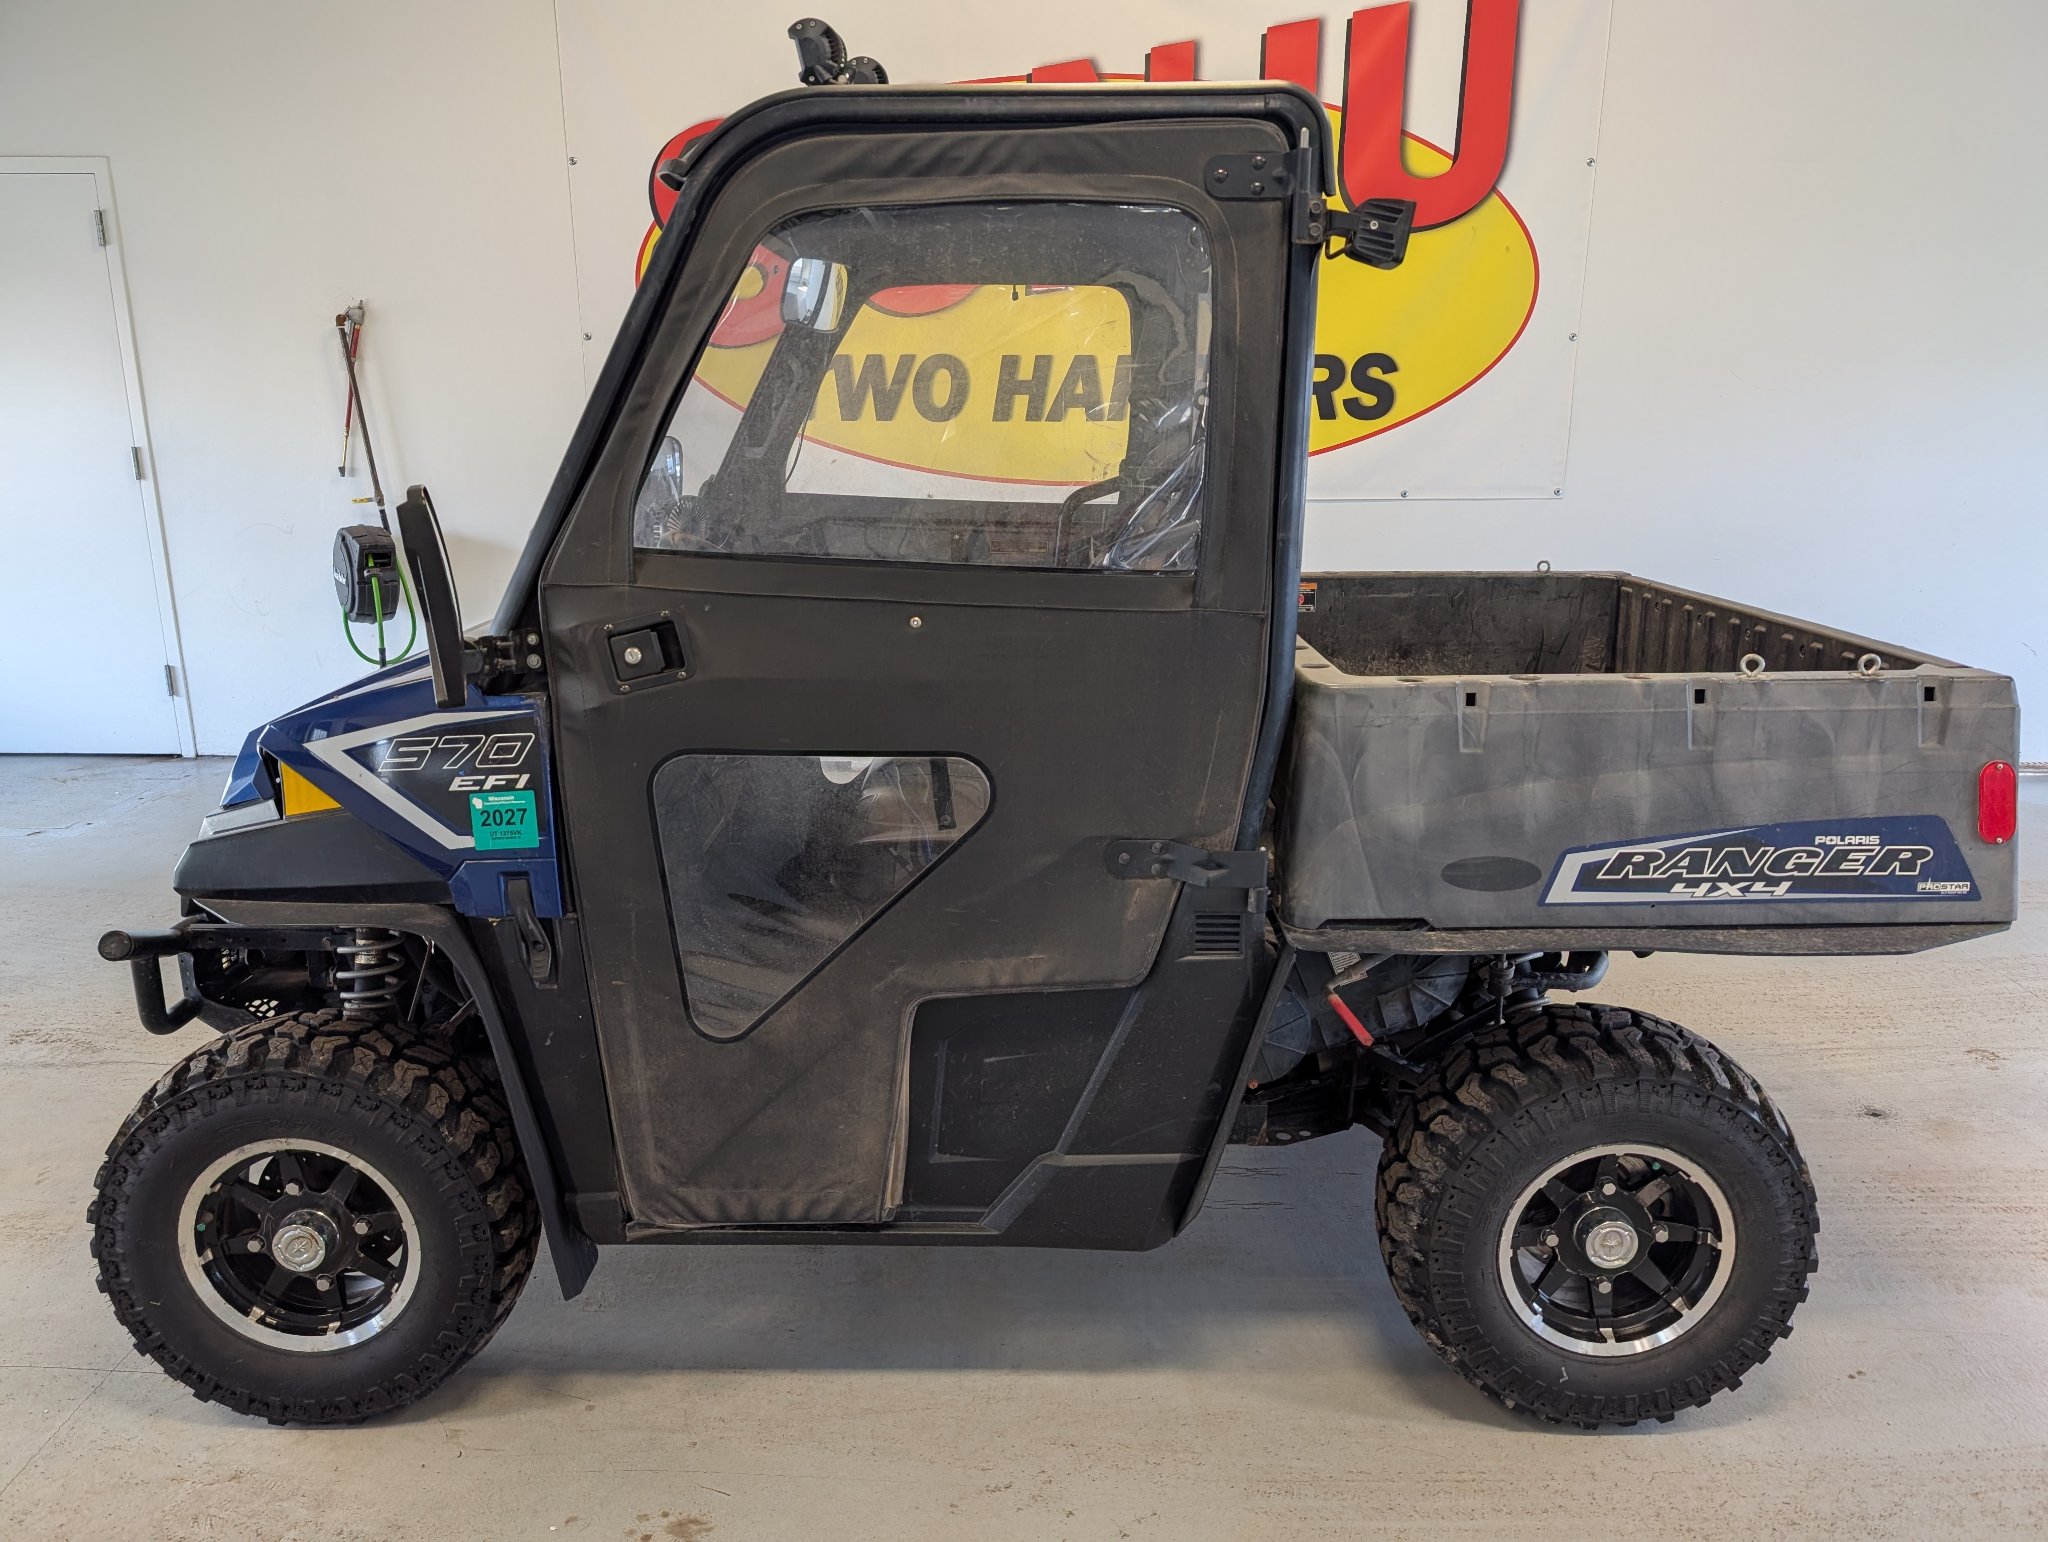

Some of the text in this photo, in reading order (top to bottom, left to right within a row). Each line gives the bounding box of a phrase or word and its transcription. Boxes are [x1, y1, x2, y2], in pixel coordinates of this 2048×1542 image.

[810, 353, 970, 423] WO
[378, 733, 536, 772] 570
[448, 773, 531, 792] EFI
[480, 808, 527, 827] 2027
[1815, 835, 1880, 845] POLARIS
[1597, 845, 1933, 879] RANGER
[1670, 880, 1792, 897] 4X4
[1918, 882, 1969, 891] PROSTAR
